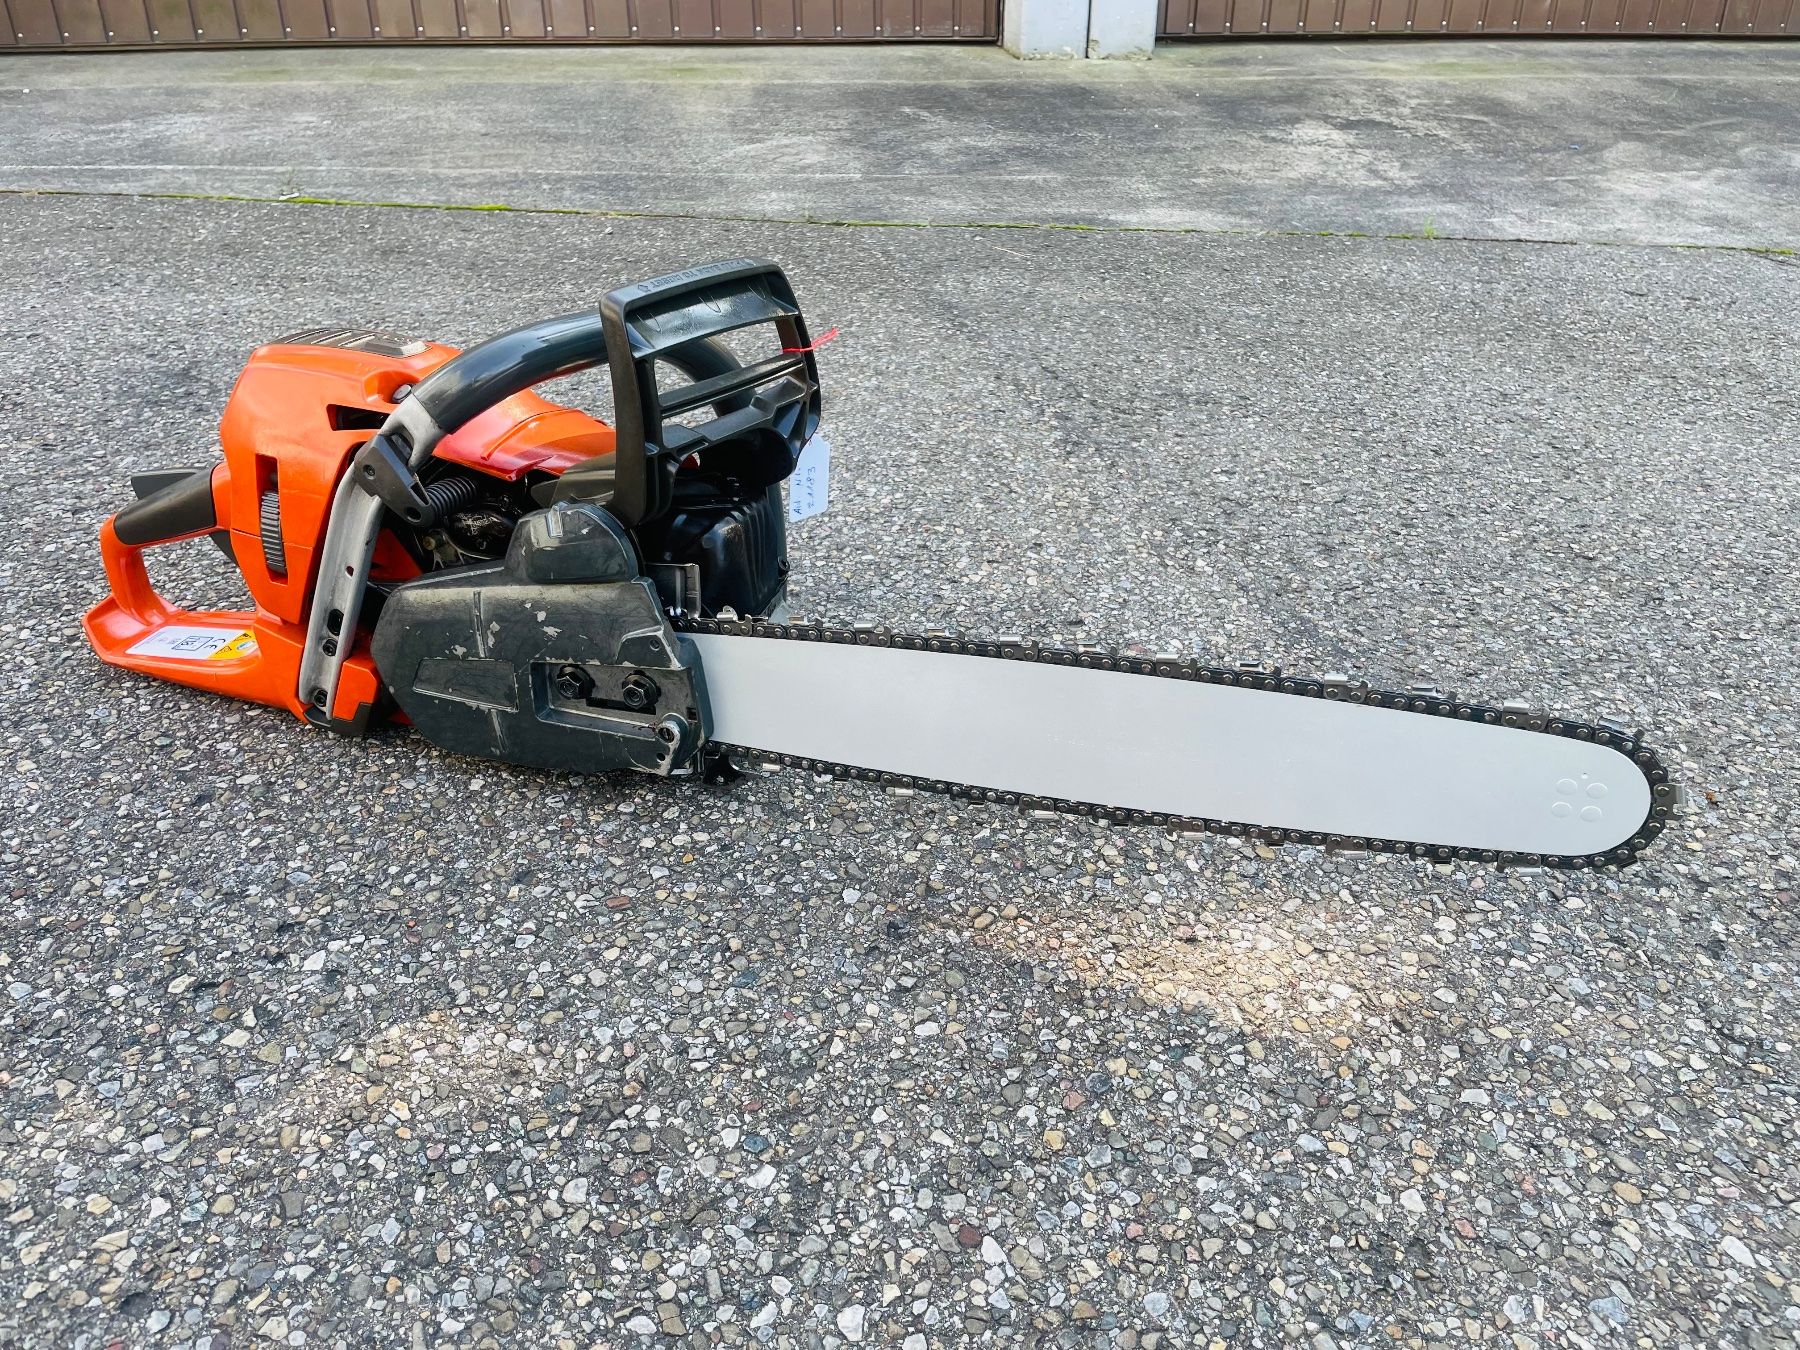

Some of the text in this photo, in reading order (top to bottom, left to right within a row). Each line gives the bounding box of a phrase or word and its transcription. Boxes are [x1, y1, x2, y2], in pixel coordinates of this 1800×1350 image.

[699, 265, 720, 274] BACK
[684, 270, 698, 279] TO
[651, 274, 682, 288] RESET
